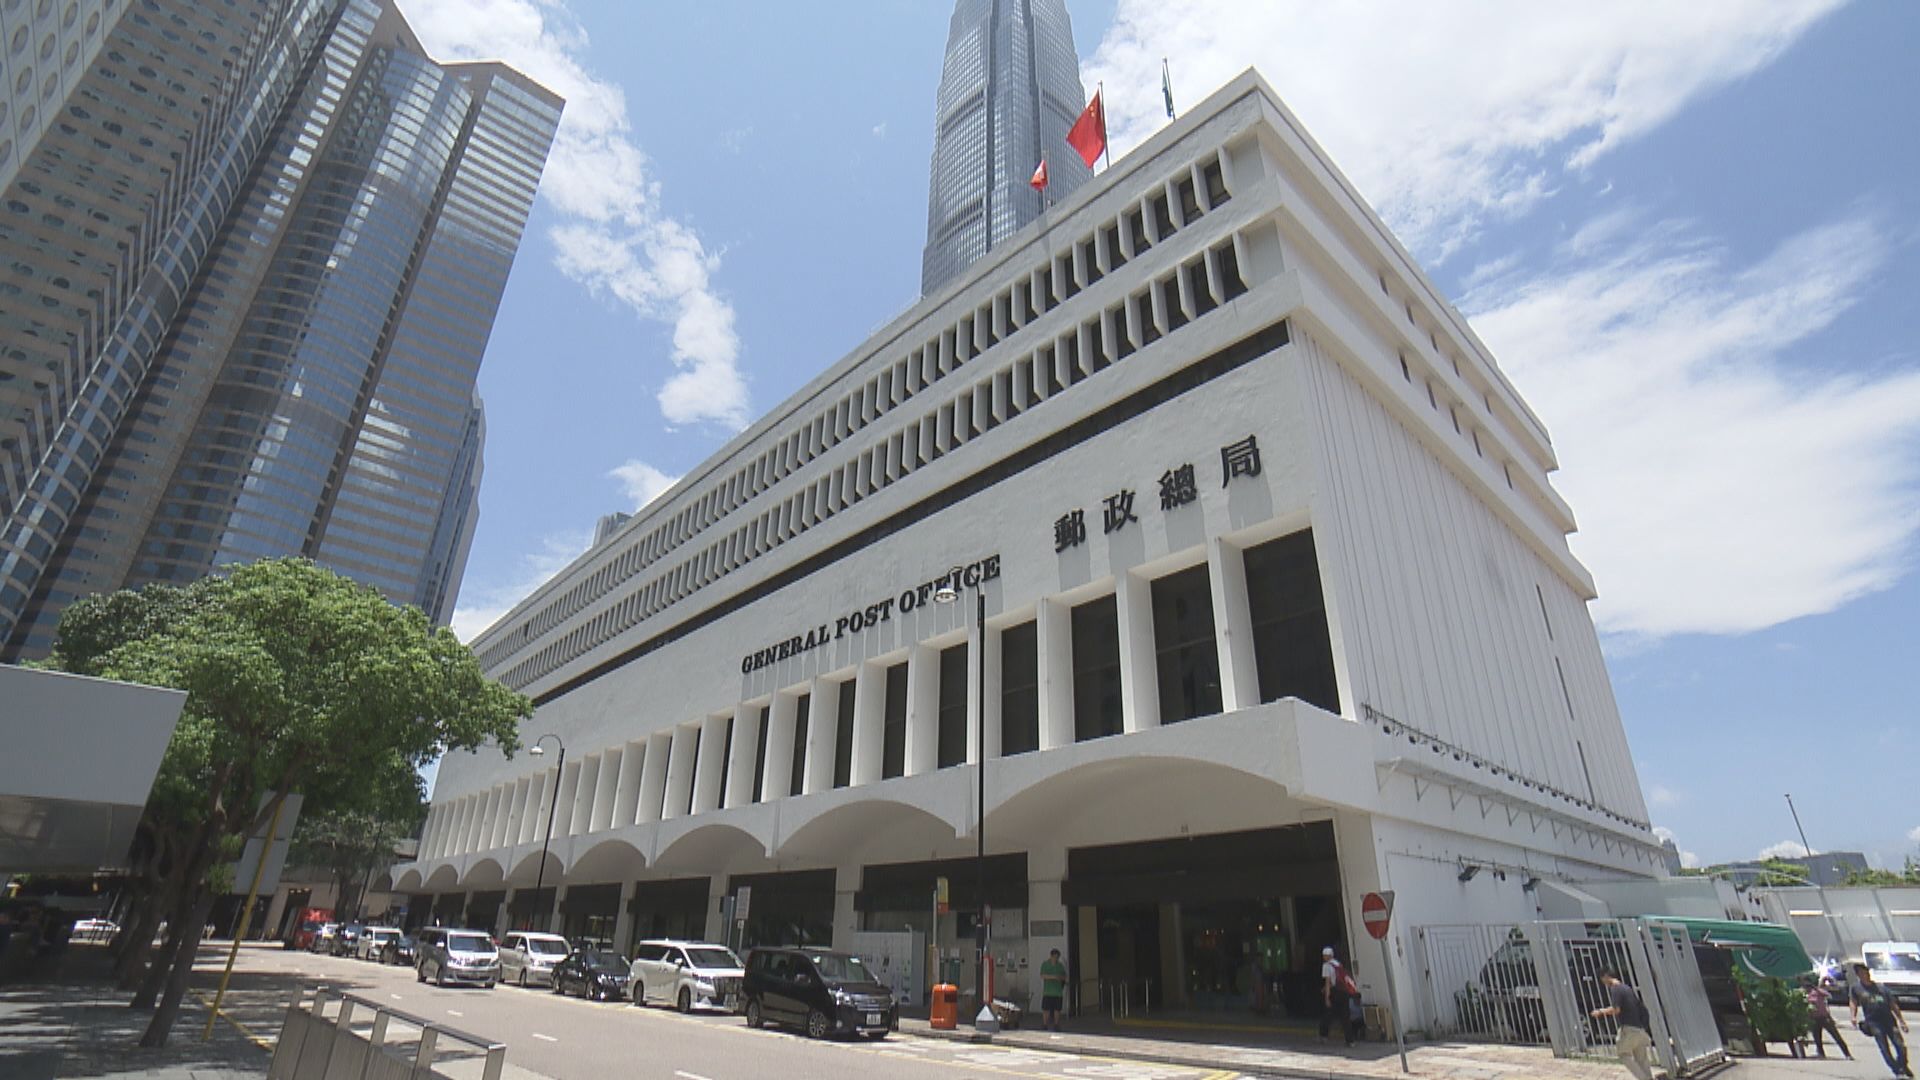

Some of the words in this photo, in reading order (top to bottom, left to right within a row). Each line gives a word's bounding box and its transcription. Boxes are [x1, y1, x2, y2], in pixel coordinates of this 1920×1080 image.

[1054, 434, 1261, 553] 郵政總局
[741, 624, 830, 674] GENERAL
[834, 598, 894, 639] POST
